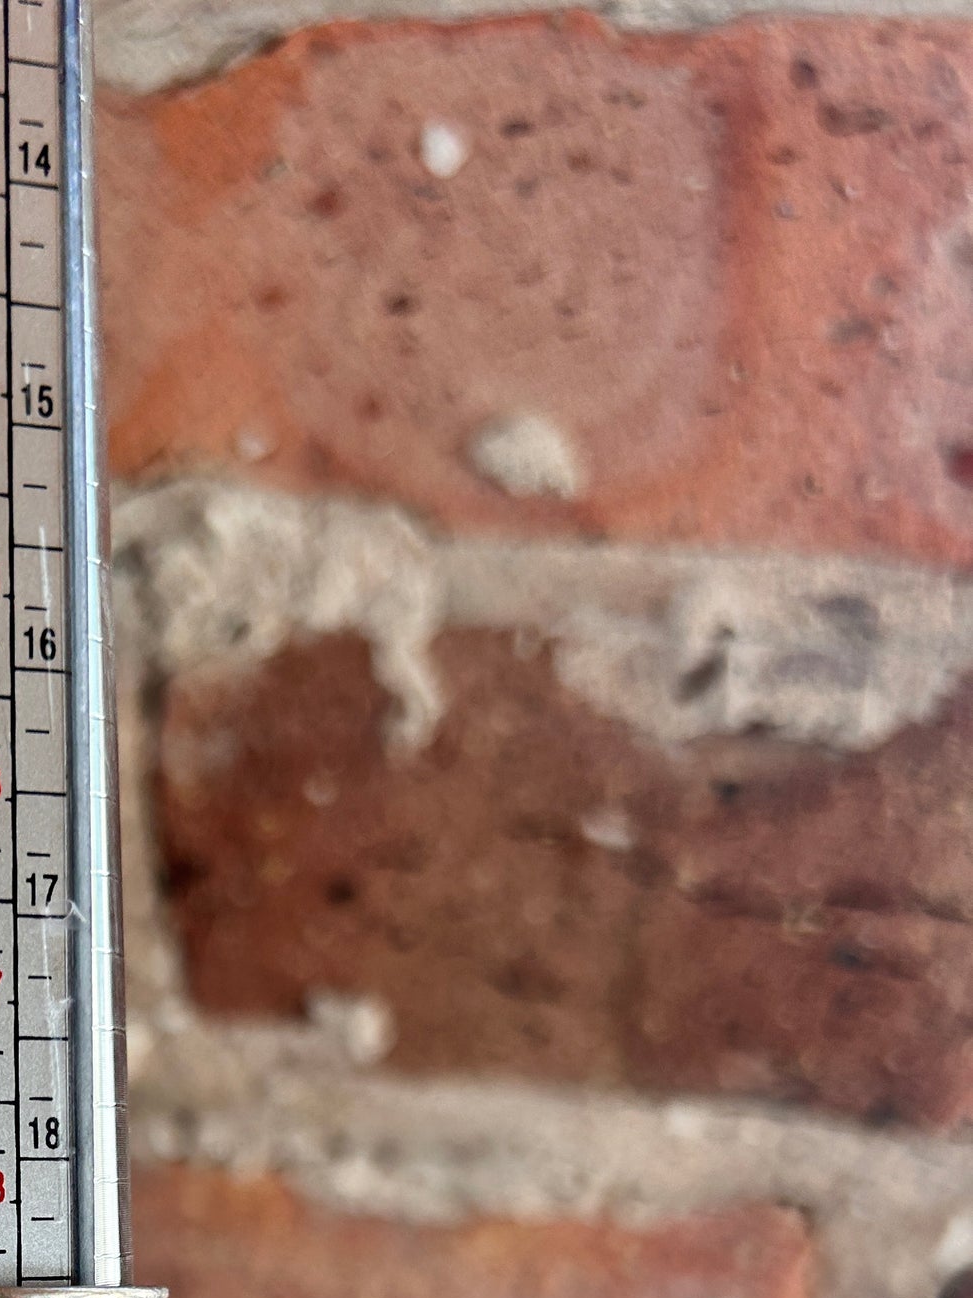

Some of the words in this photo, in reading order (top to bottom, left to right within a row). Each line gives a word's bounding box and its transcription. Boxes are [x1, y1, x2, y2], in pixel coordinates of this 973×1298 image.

[18, 140, 52, 178] 14
[20, 383, 54, 419] 15
[23, 625, 57, 662] 16
[25, 872, 59, 907] 17
[28, 1116, 60, 1150] 18
